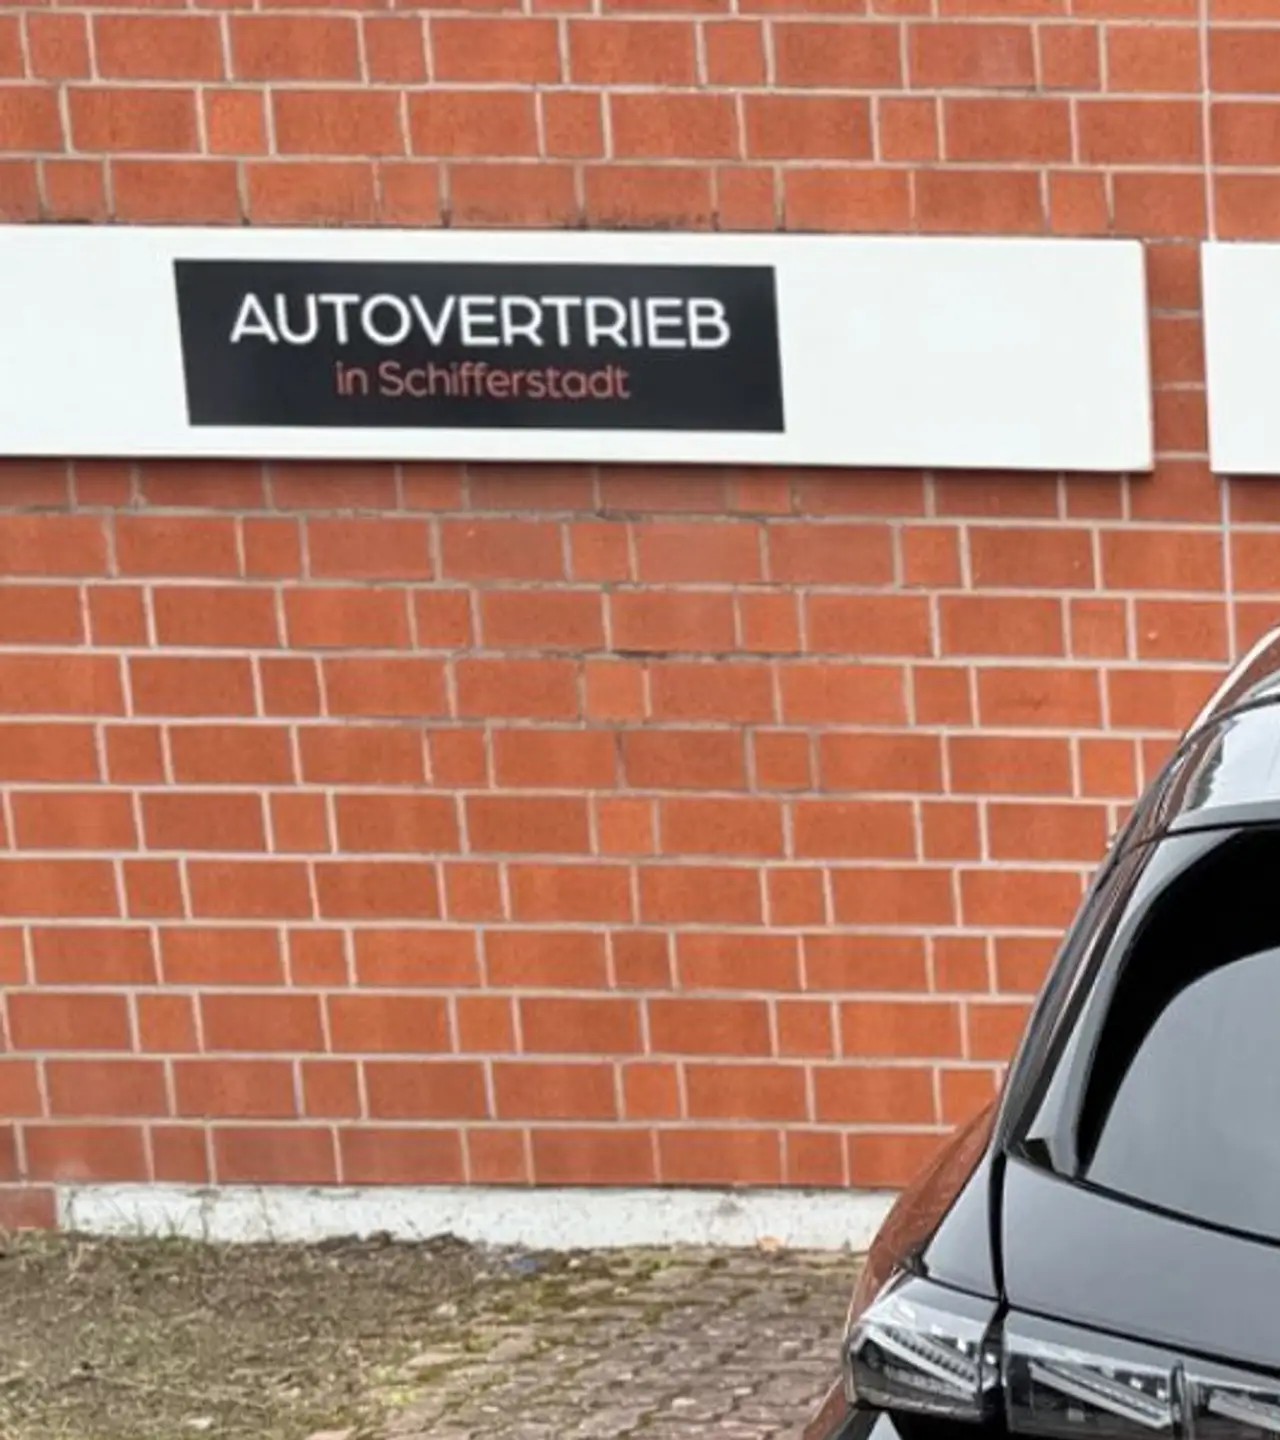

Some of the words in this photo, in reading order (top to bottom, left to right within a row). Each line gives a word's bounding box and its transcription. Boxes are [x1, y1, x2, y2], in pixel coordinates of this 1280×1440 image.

[229, 292, 732, 350] AUTOVERTRIEB
[335, 361, 369, 396] in
[378, 360, 631, 400] Schifferstadt
